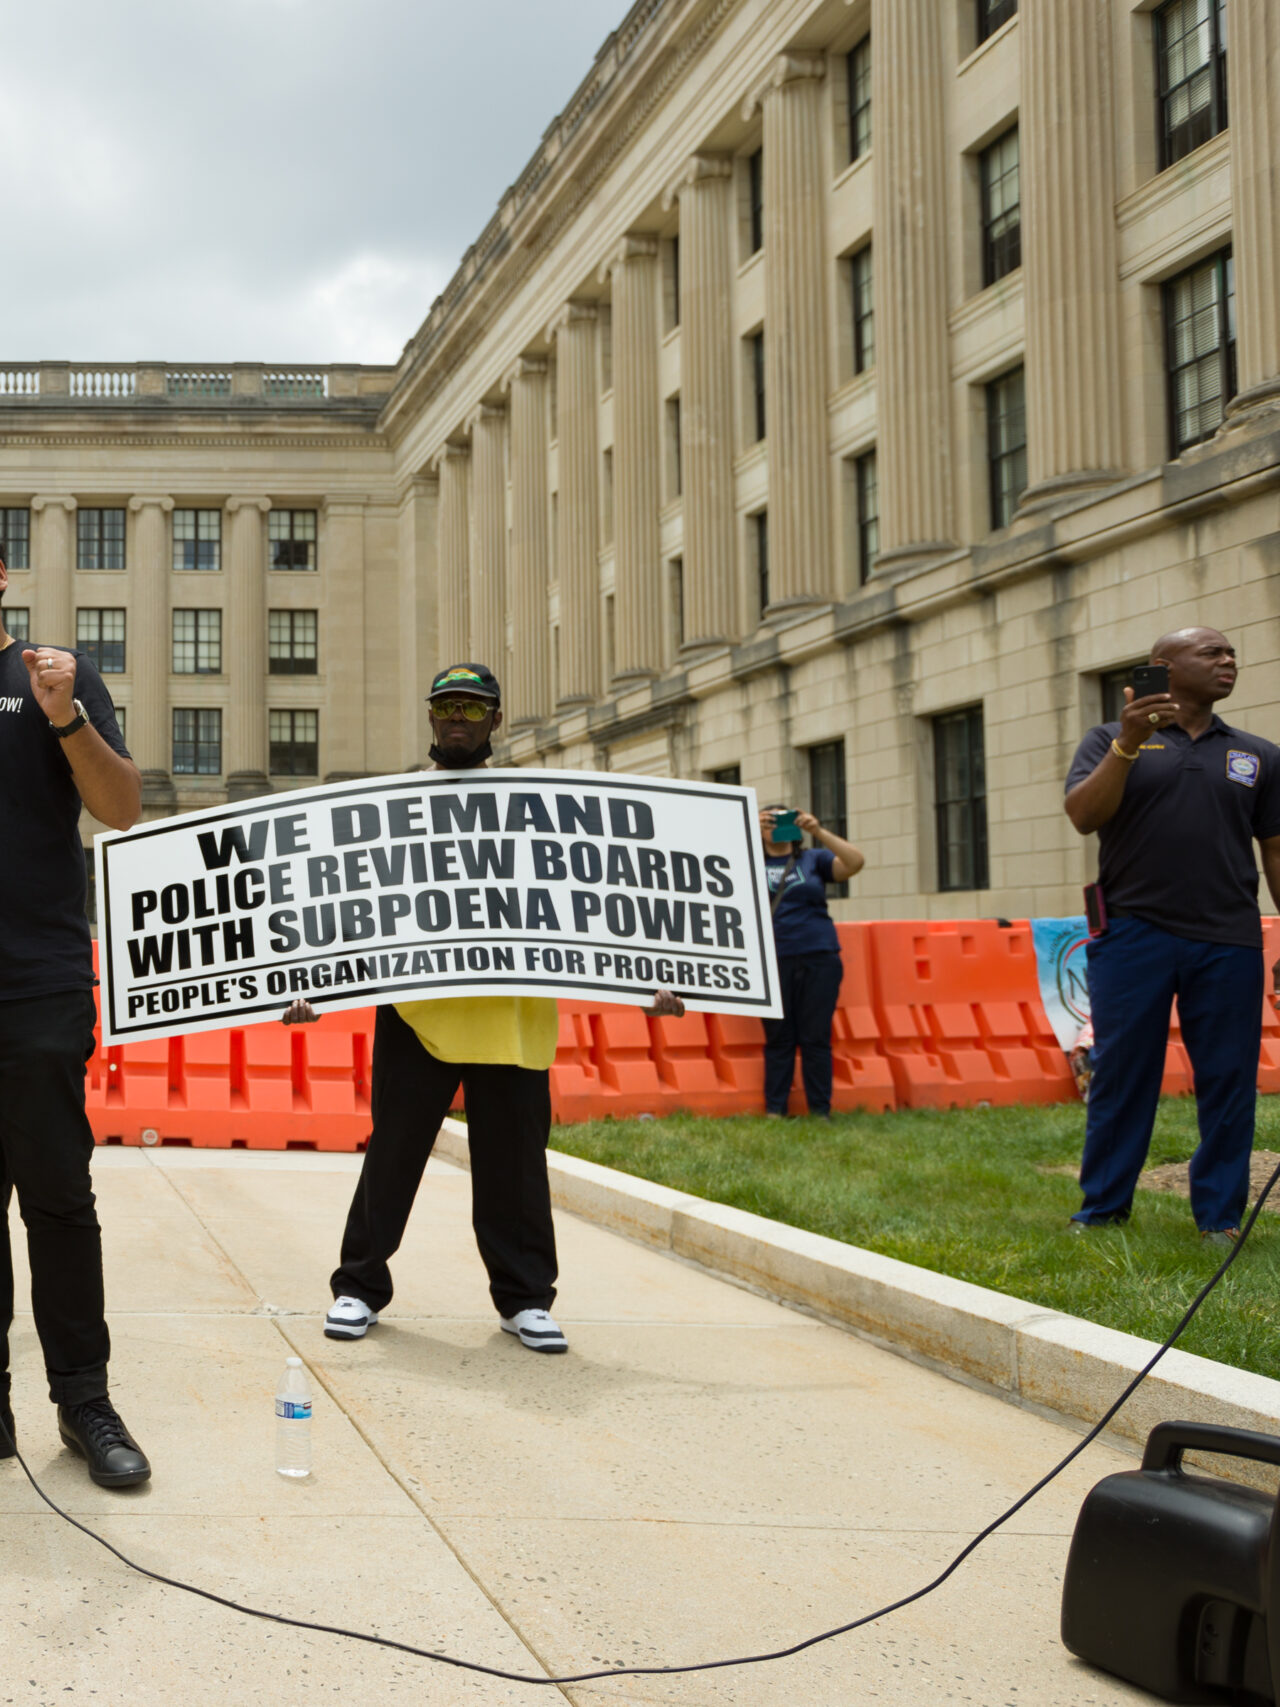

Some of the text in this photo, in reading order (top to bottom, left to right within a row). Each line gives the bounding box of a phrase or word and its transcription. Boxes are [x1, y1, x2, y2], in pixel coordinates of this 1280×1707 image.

[197, 793, 654, 870] WE DEMAND
[132, 839, 734, 931] POLICE REVIEW BOARDS
[127, 886, 745, 978] WITH SUBPOENA POWER
[128, 947, 750, 1018] PEOPLE'S ORGANIZATION FOR PROGRESS
